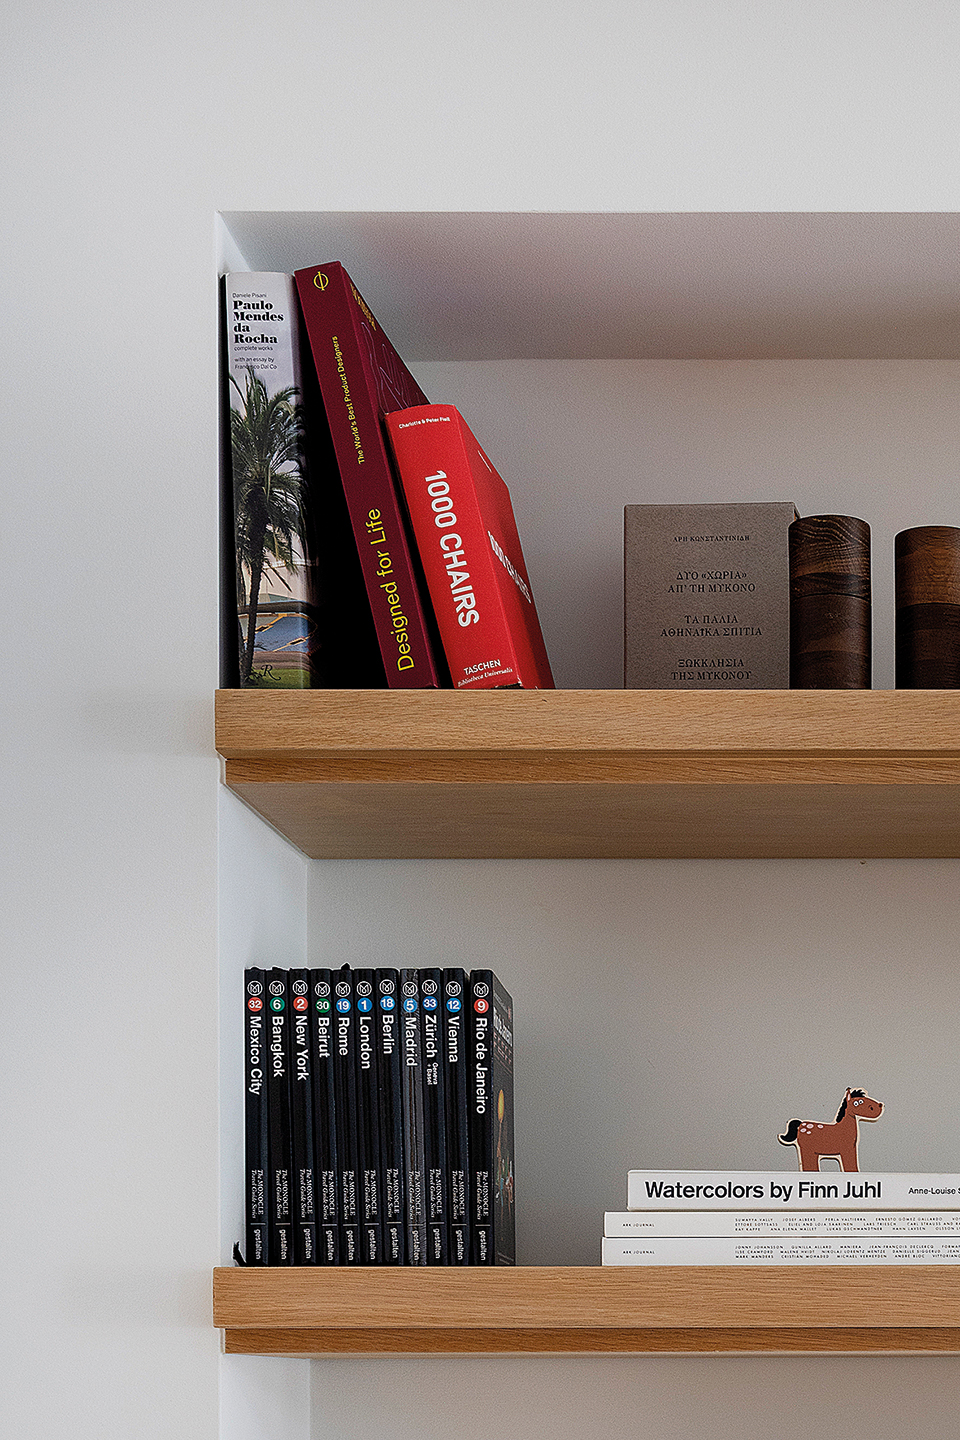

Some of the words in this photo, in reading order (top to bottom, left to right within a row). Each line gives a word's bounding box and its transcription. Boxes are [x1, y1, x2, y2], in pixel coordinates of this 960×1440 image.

[233, 300, 273, 310] Paulo
[234, 312, 284, 321] Mendes
[234, 323, 250, 332] da
[234, 334, 278, 344] Rocha
[332, 335, 345, 373] Designers
[338, 373, 350, 402] Product
[346, 403, 356, 420] Best
[398, 419, 422, 429] Charlotte
[351, 420, 362, 450] World's
[424, 470, 458, 528] 1000
[366, 508, 386, 545] Life
[377, 550, 394, 578] for
[440, 533, 480, 628] CHAIRS
[676, 571, 698, 580] ΔΥΟ
[701, 571, 747, 580] «ΧΩΡΙΑ»
[689, 584, 705, 593] ΤΗ
[708, 583, 756, 592] ΜΥΚΟΝΟ
[380, 581, 414, 672] Designed
[684, 615, 699, 624] ΤΑ
[703, 615, 738, 623] ΠΑΛΙΑ
[723, 627, 762, 636] ΣΠΙΤΙΑ
[463, 659, 501, 676] TASCHEN
[678, 659, 744, 668] ΞΩΚΚΛΗΣΙΑ
[671, 672, 694, 680] ΤΗΣ
[697, 670, 752, 680] ΜΥΚΟΝΟΥ
[249, 1000, 262, 1009] 32
[273, 1000, 281, 1010] 6
[297, 999, 305, 1009] 2
[316, 1001, 329, 1010] 30
[338, 1001, 349, 1010] 19
[361, 1000, 367, 1010] 1
[381, 999, 394, 1007] 18
[406, 1001, 414, 1010] 5
[423, 999, 436, 1008] 33
[448, 1000, 460, 1010] 12
[477, 1000, 486, 1011] 9
[296, 1016, 308, 1046] New
[338, 1018, 350, 1056] Rome
[382, 1015, 395, 1054] Berlin
[425, 1015, 438, 1058] Zürich
[476, 1018, 488, 1040] Rio
[250, 1016, 262, 1064] Mexico
[270, 1016, 285, 1077] Bangkok
[318, 1018, 330, 1058] Beirut
[360, 1017, 372, 1069] London
[405, 1017, 418, 1066] Madrid
[448, 1016, 460, 1062] Vienna
[476, 1043, 488, 1060] de
[296, 1049, 309, 1080] York
[248, 1068, 263, 1095] City
[476, 1063, 488, 1114] Janeiro
[645, 1181, 764, 1199] Watercolors
[770, 1181, 793, 1202] by
[799, 1181, 838, 1198] Finn
[842, 1182, 881, 1199] Juhl
[908, 1187, 956, 1195] Anne-Louise
[254, 1229, 262, 1260] gestalten
